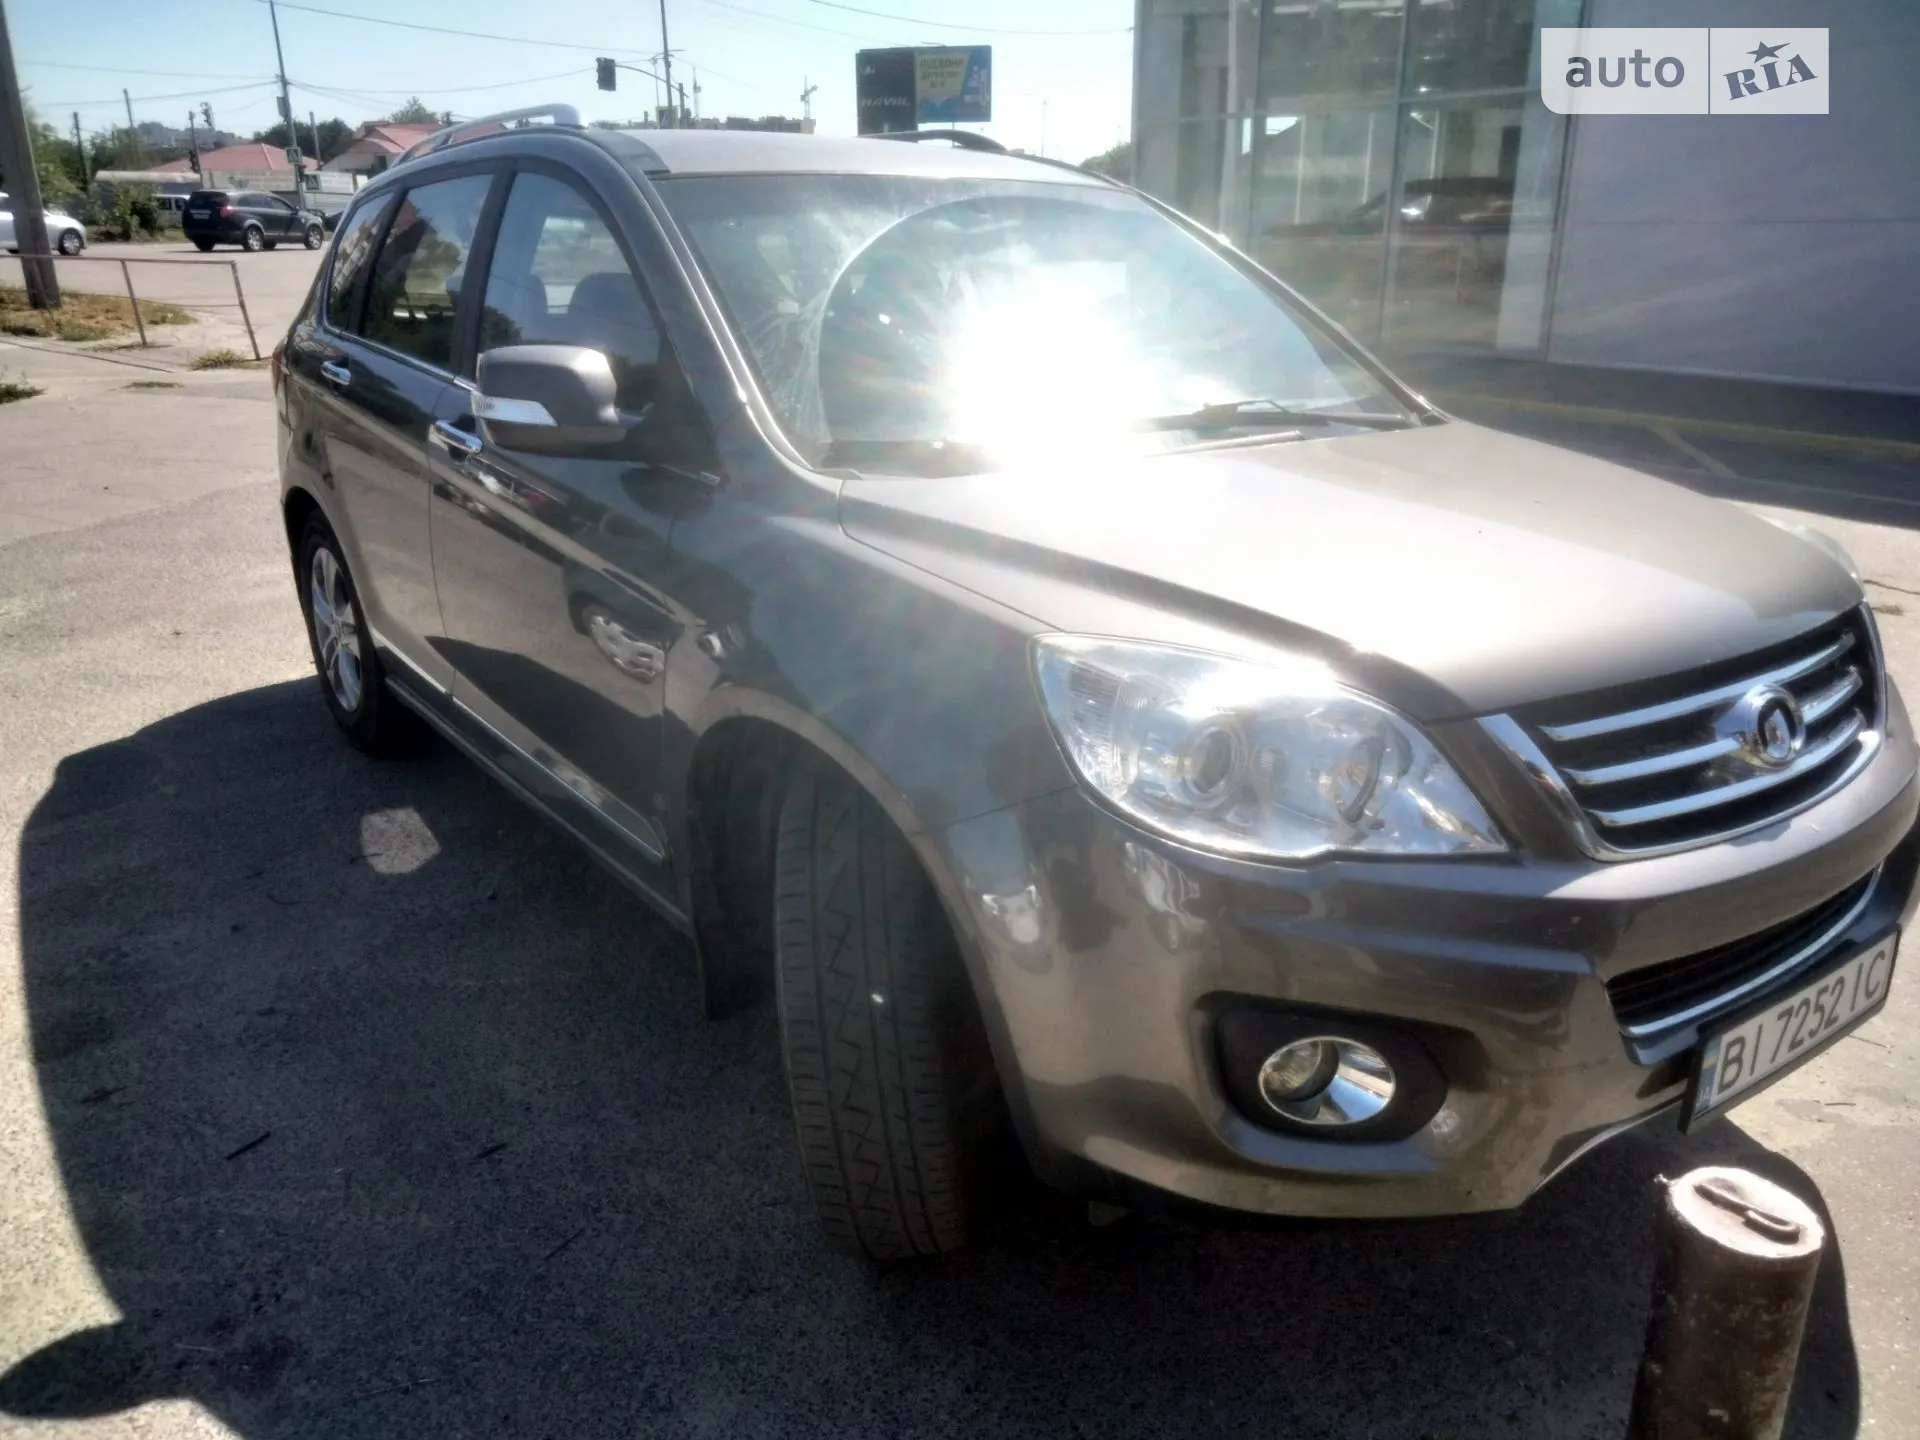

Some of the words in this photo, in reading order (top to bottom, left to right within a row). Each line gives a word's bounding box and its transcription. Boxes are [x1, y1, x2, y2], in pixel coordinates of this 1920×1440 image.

[1717, 1024, 1763, 1095] BI
[1770, 976, 1845, 1064] 7252
[1850, 950, 1886, 1013] IC
